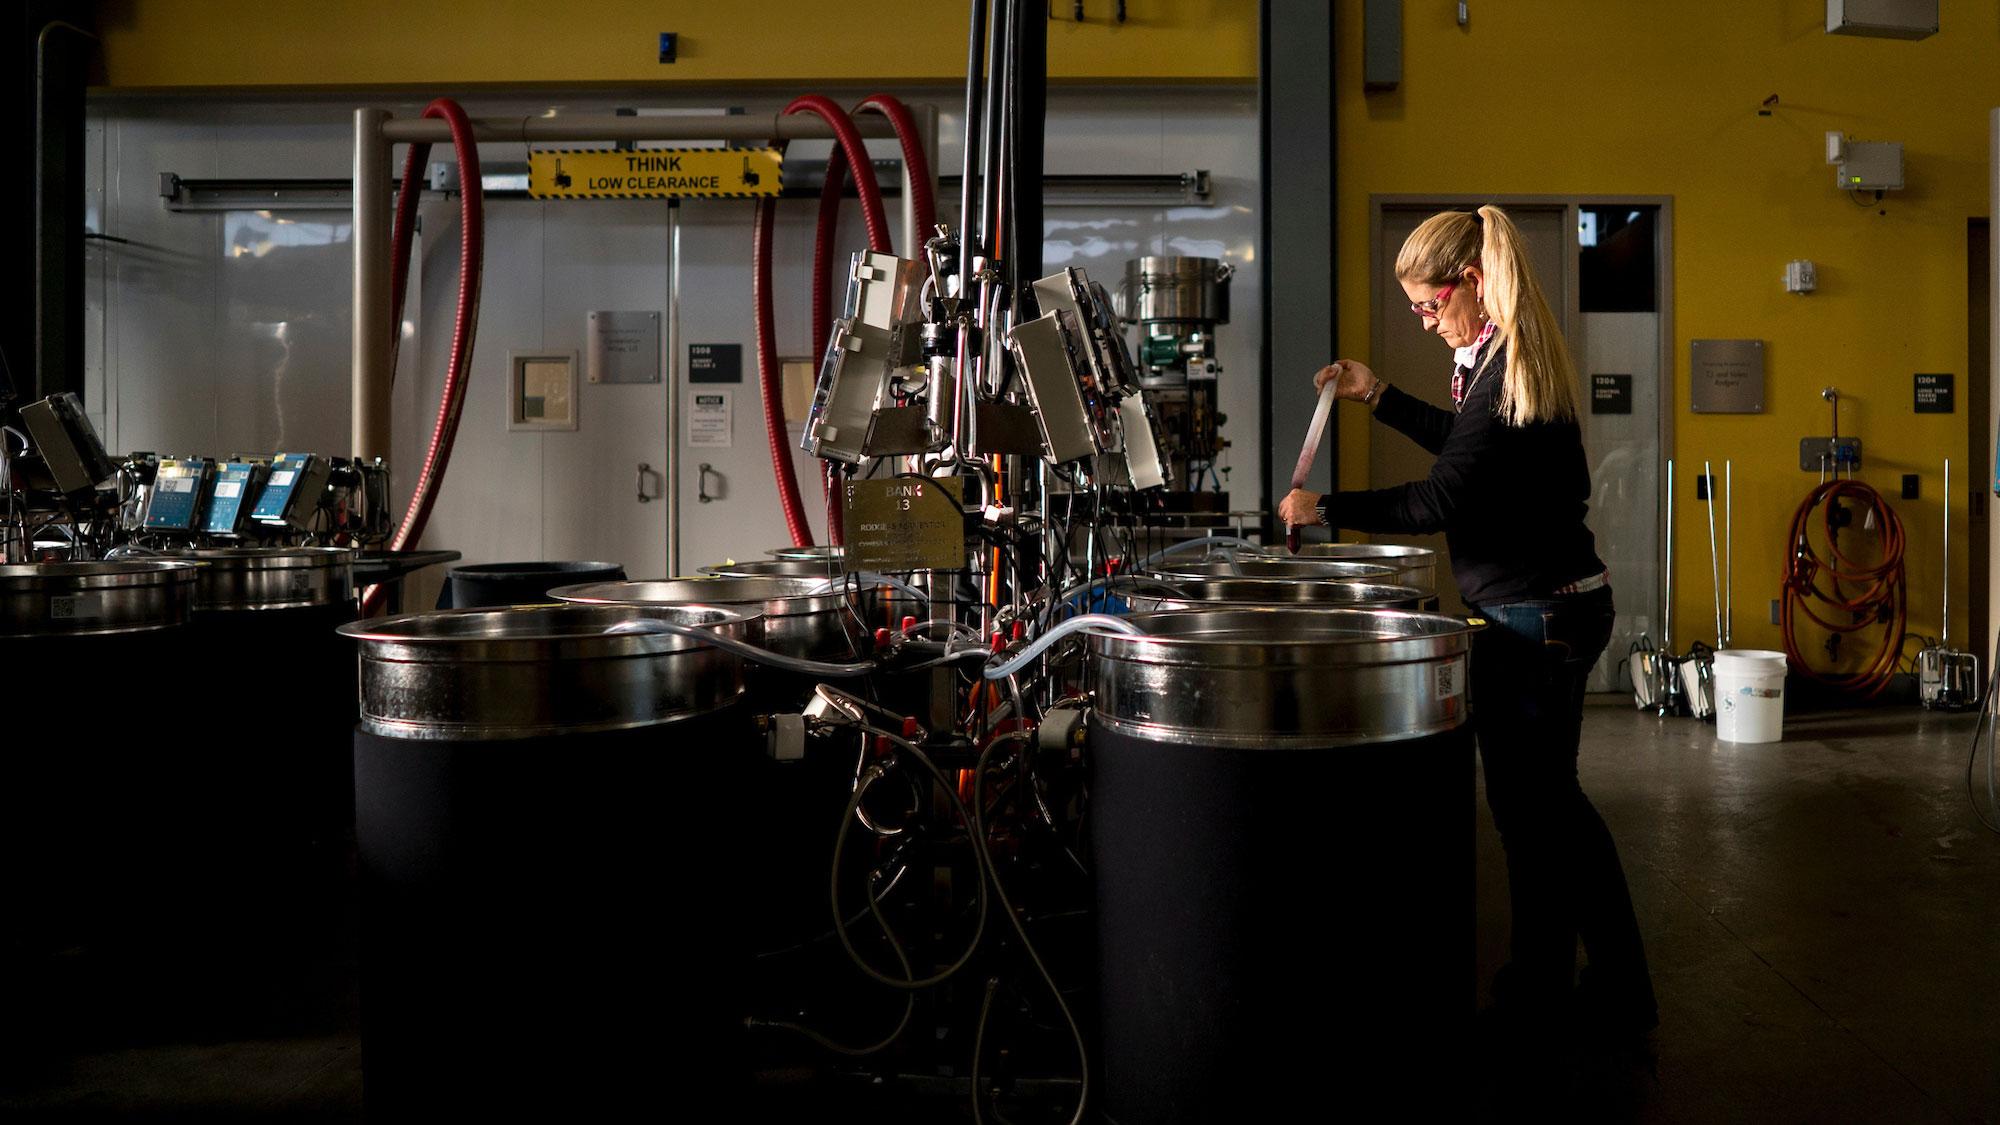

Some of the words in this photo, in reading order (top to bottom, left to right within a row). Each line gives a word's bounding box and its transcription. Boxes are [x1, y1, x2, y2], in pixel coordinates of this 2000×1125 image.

[626, 157, 681, 171] THINK
[589, 177, 623, 190] LOW
[627, 176, 719, 189] CLEARANCE
[886, 485, 923, 497] BANK
[896, 499, 911, 511] 13
